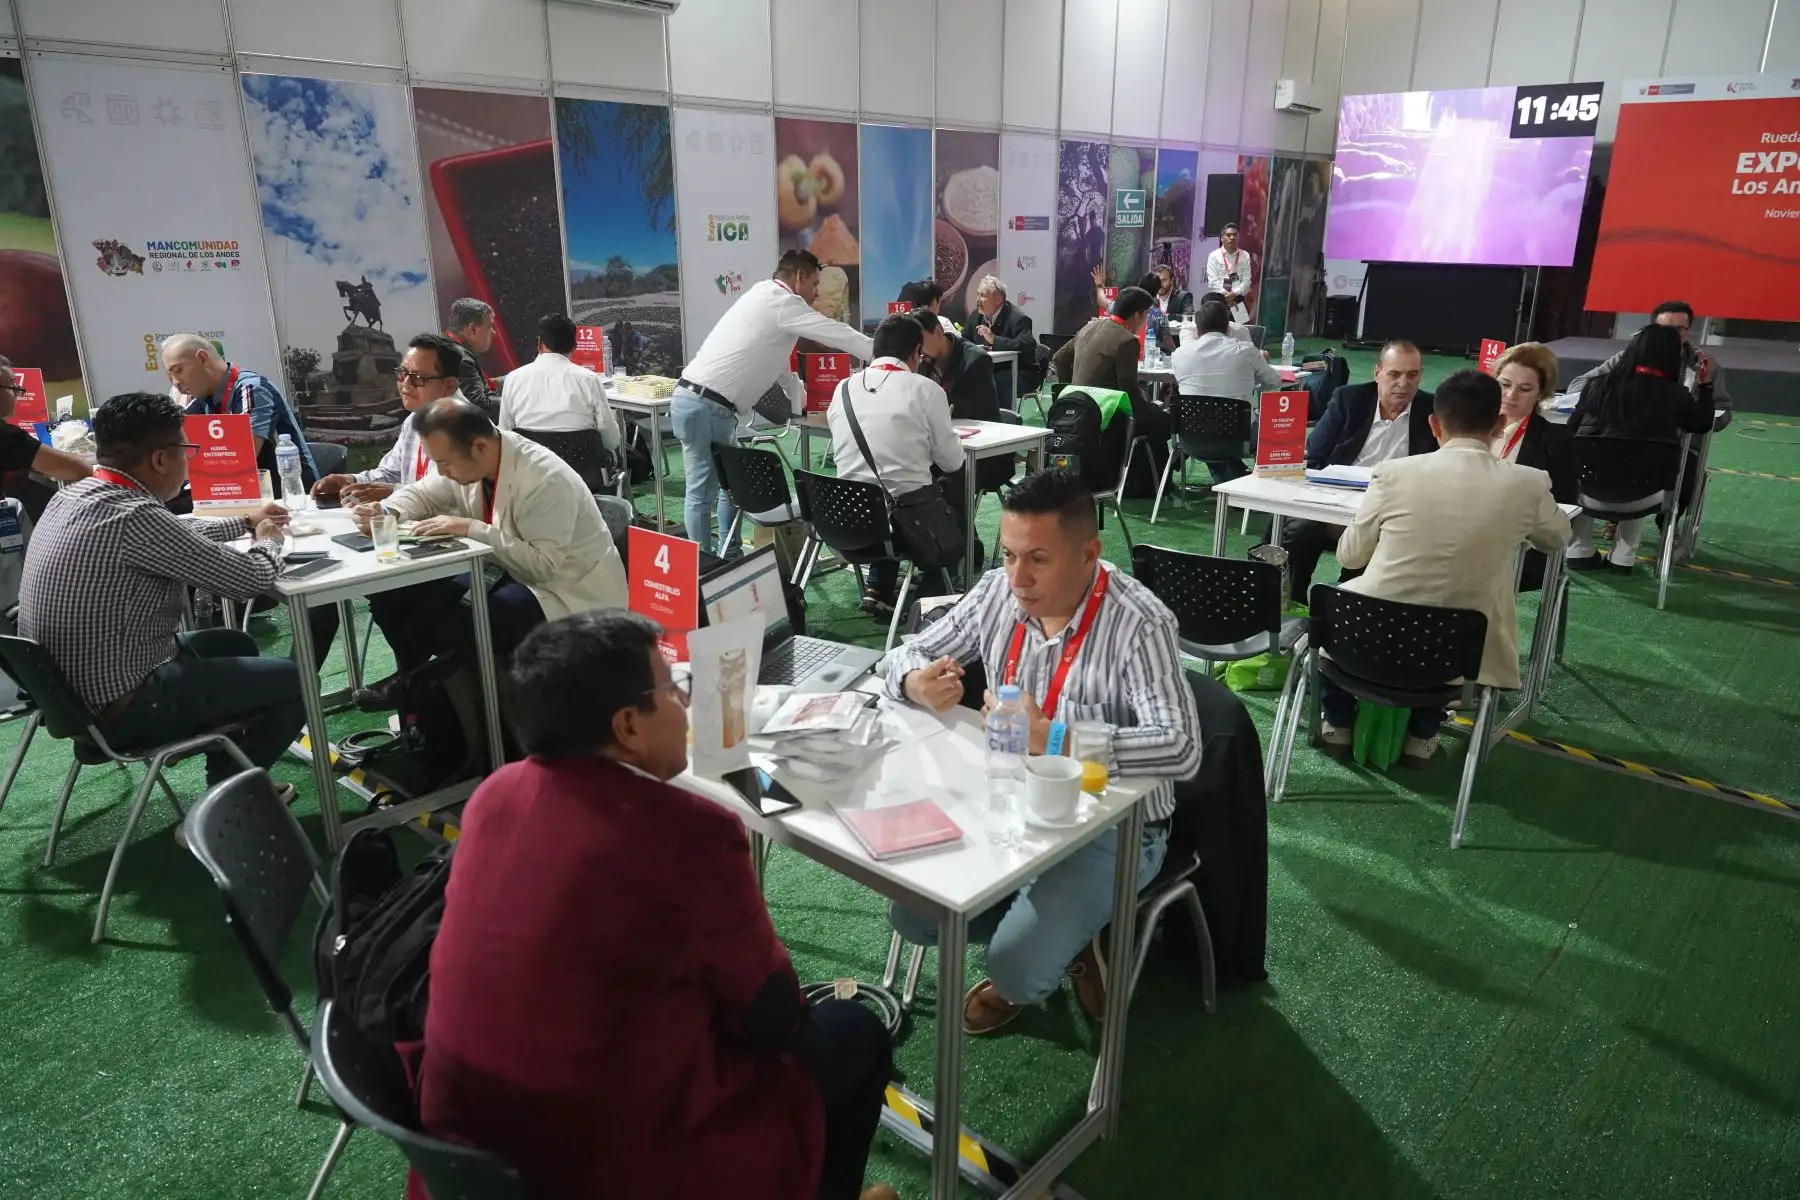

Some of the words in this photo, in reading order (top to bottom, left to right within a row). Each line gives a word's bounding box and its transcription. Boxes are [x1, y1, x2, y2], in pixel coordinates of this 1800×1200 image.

[1517, 94, 1600, 125] 11:45
[1735, 151, 1800, 173] EXP
[1731, 178, 1768, 195] Los
[1117, 214, 1143, 225] SALIDA
[717, 222, 749, 241] ICA
[147, 240, 239, 250] MANCOMUNIDAD
[149, 251, 187, 259] REGIONAL
[188, 251, 198, 259] DE
[579, 329, 594, 340] 12
[143, 333, 159, 371] Expo
[1486, 343, 1498, 356] 14
[818, 356, 837, 370] 11
[1279, 395, 1290, 413] 9
[208, 419, 225, 440] 6
[654, 544, 670, 574] 4
